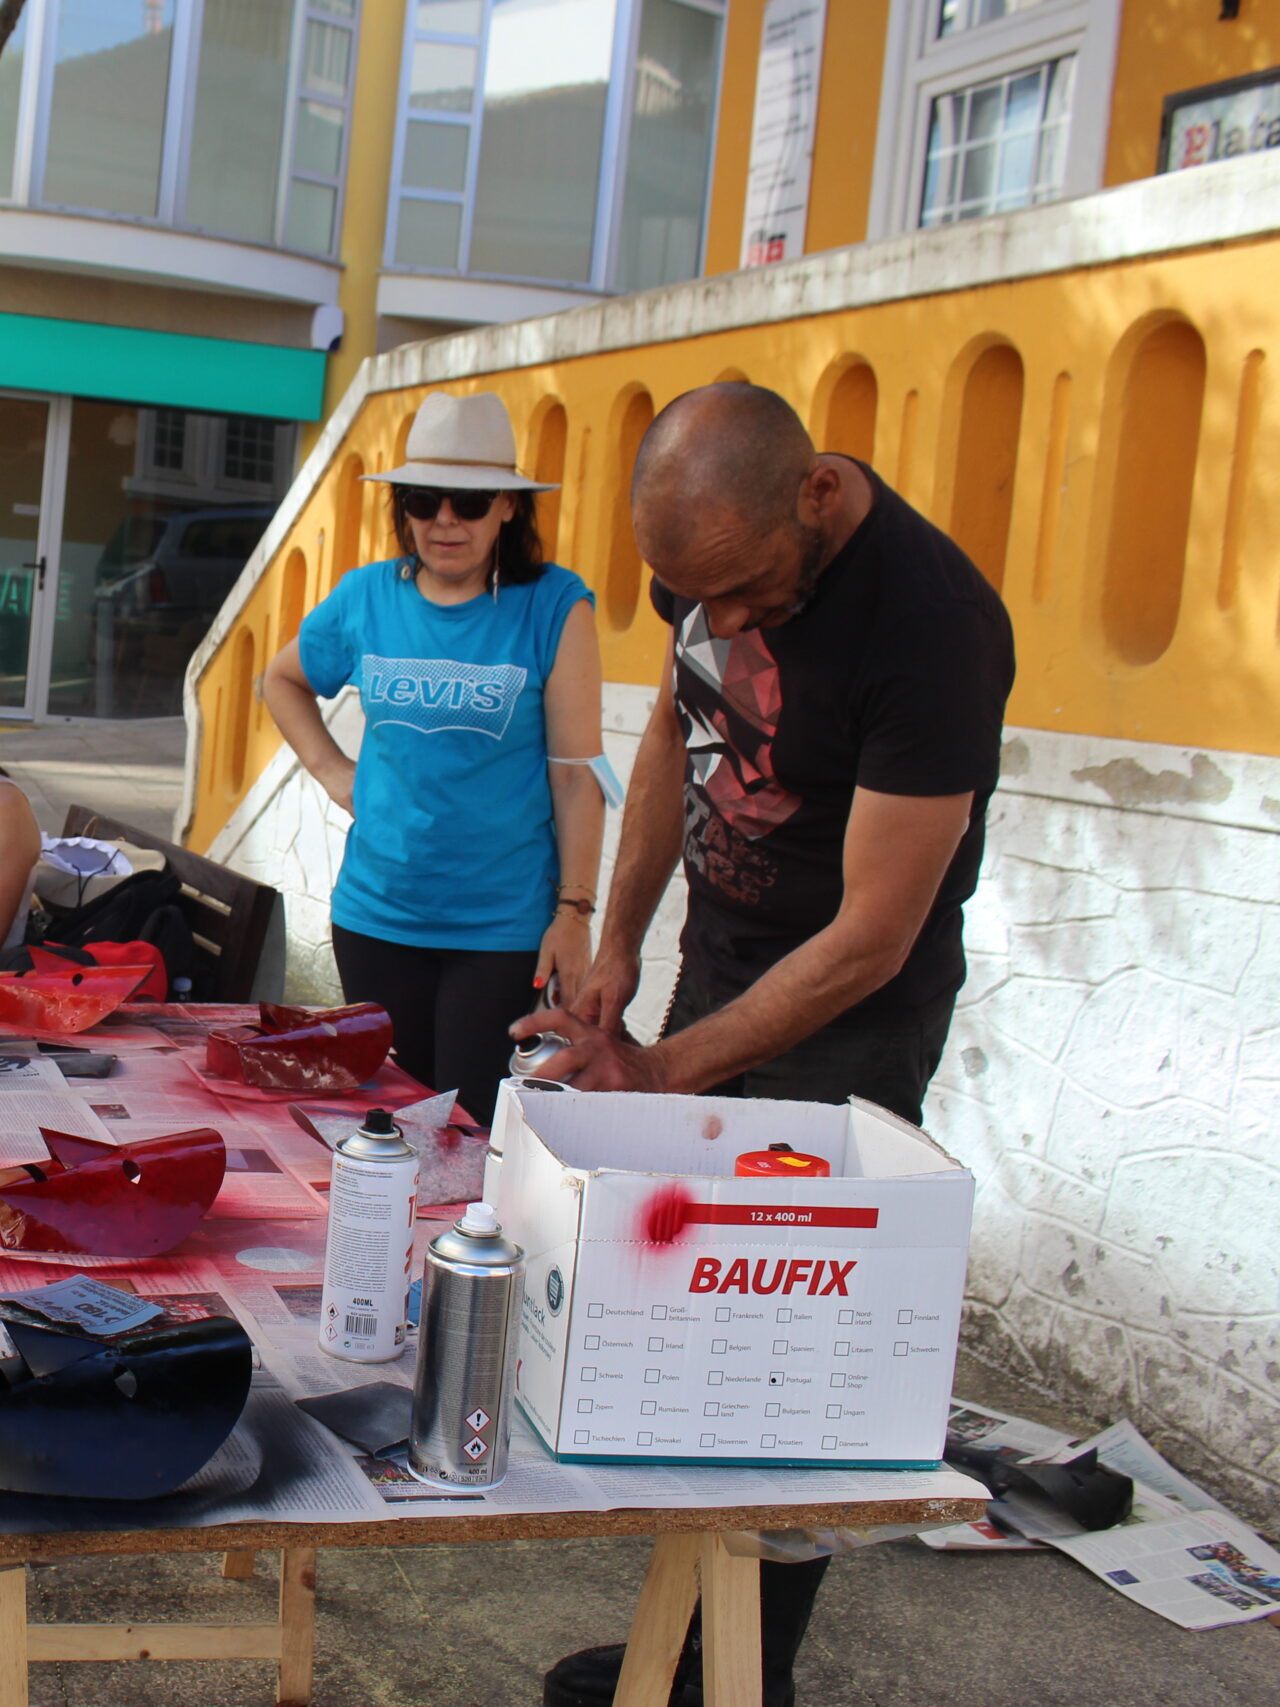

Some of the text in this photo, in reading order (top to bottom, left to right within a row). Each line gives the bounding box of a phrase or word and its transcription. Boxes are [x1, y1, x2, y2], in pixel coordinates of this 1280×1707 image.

[750, 1211, 812, 1222] 12 x 400 ml
[688, 1257, 858, 1297] BAUFIX
[606, 1308, 644, 1316] Deutschland
